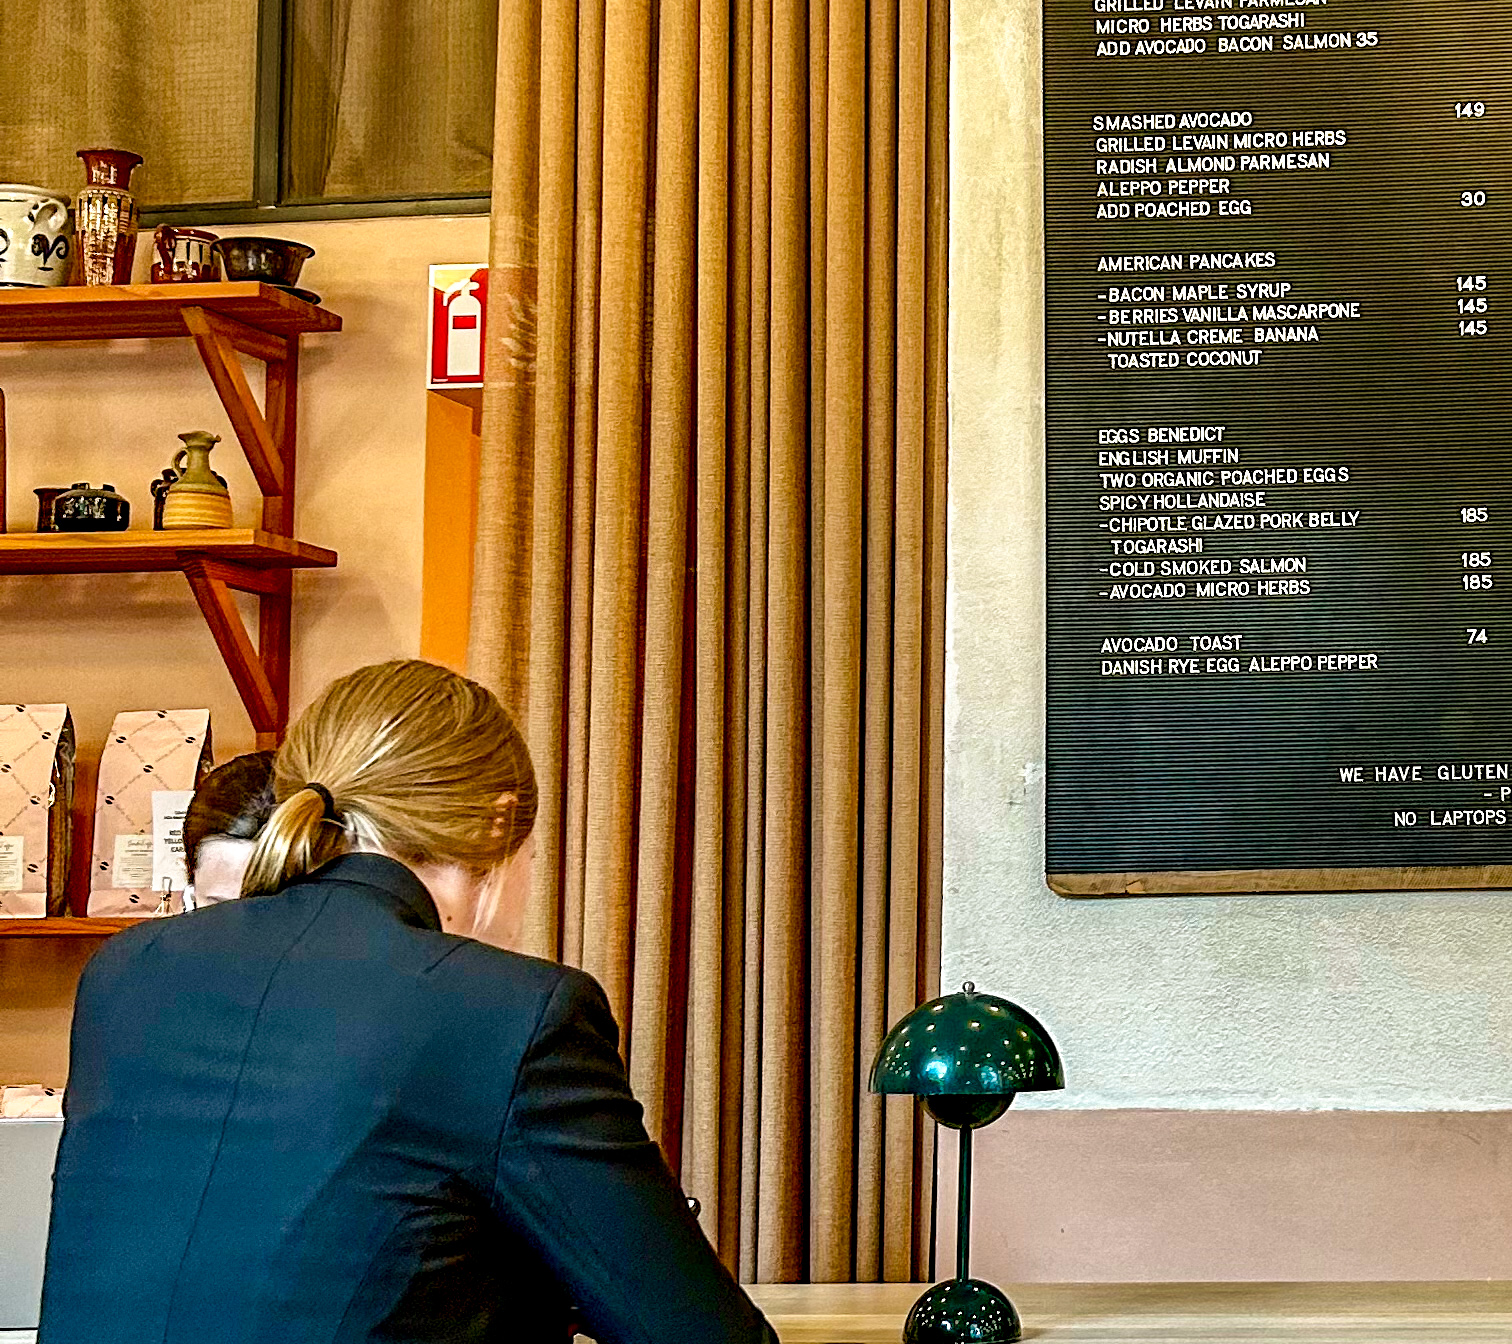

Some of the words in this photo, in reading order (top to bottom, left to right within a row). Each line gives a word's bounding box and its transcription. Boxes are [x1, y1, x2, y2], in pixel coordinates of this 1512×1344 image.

[1454, 101, 1485, 119] 149
[1092, 113, 1176, 131] SMASHED
[1178, 111, 1253, 129] AVOCADO
[1096, 136, 1166, 153] GRILLED
[1172, 133, 1229, 151] LEVAIN
[1233, 132, 1288, 149] MICRO
[1292, 129, 1347, 147] HERBS
[1096, 180, 1162, 197] ALEPPO
[1168, 178, 1230, 195] PEPPER
[1460, 190, 1486, 207] 30
[1096, 203, 1130, 219] ADD
[1134, 200, 1211, 218] POACHED
[1218, 199, 1252, 216] EGG
[1097, 254, 1183, 272] AMERICAN
[1189, 251, 1276, 270] PANCAKES
[1172, 284, 1229, 301] MAPLE
[1236, 282, 1291, 299] SYRUP
[1456, 275, 1487, 292] 145
[1186, 328, 1244, 345] CREME
[1254, 325, 1319, 343] BANANA
[1107, 352, 1180, 369] TOASTED
[1186, 349, 1263, 367] COCONUT
[1098, 428, 1140, 445] EGGS
[1147, 426, 1226, 443] BENEDICT
[1098, 449, 1169, 467] ENGLISH
[1177, 447, 1239, 465] MUFFIN
[1099, 494, 1151, 511] SPICY
[1153, 491, 1266, 510] HOLLANDAISE
[1191, 514, 1256, 531] GLAZED
[1259, 512, 1304, 530] PORK
[1308, 510, 1360, 528] BELLY
[1460, 507, 1489, 523] 185
[1159, 559, 1232, 576] SMOKED
[1239, 556, 1307, 574] SALMON
[1100, 636, 1178, 654] AVOCADO
[1188, 634, 1243, 652] TOAST
[1466, 628, 1488, 645] 74
[1101, 658, 1163, 676] DANISH
[1168, 658, 1201, 674] RYE
[1206, 657, 1240, 673] EGG
[1248, 655, 1313, 672] ALEPPO
[1317, 653, 1378, 671] PEPPER
[1339, 767, 1364, 783] WE
[1374, 765, 1423, 782] HAVE
[1437, 763, 1508, 781] GLUTEN
[1394, 811, 1417, 827] NO
[1430, 809, 1507, 826] LAPTOPS
